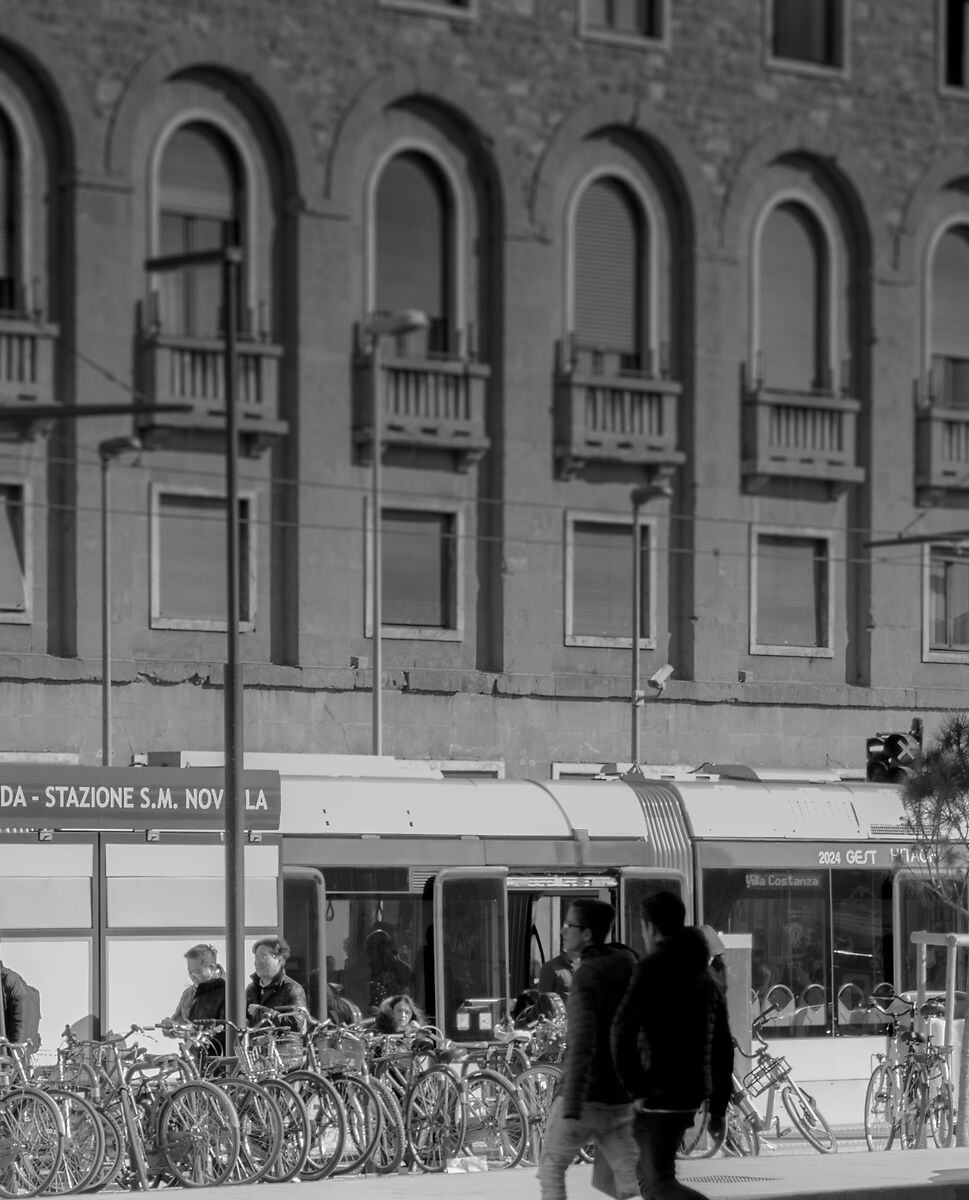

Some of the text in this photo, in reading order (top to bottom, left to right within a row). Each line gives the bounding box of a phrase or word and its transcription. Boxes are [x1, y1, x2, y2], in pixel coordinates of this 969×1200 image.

[45, 785, 134, 809] STAZIONE
[140, 787, 178, 809] S.M.
[185, 788, 268, 810] NOVLA
[818, 851, 841, 864] 2024
[846, 850, 876, 864] GEST
[745, 874, 819, 887] Villa Costanza
